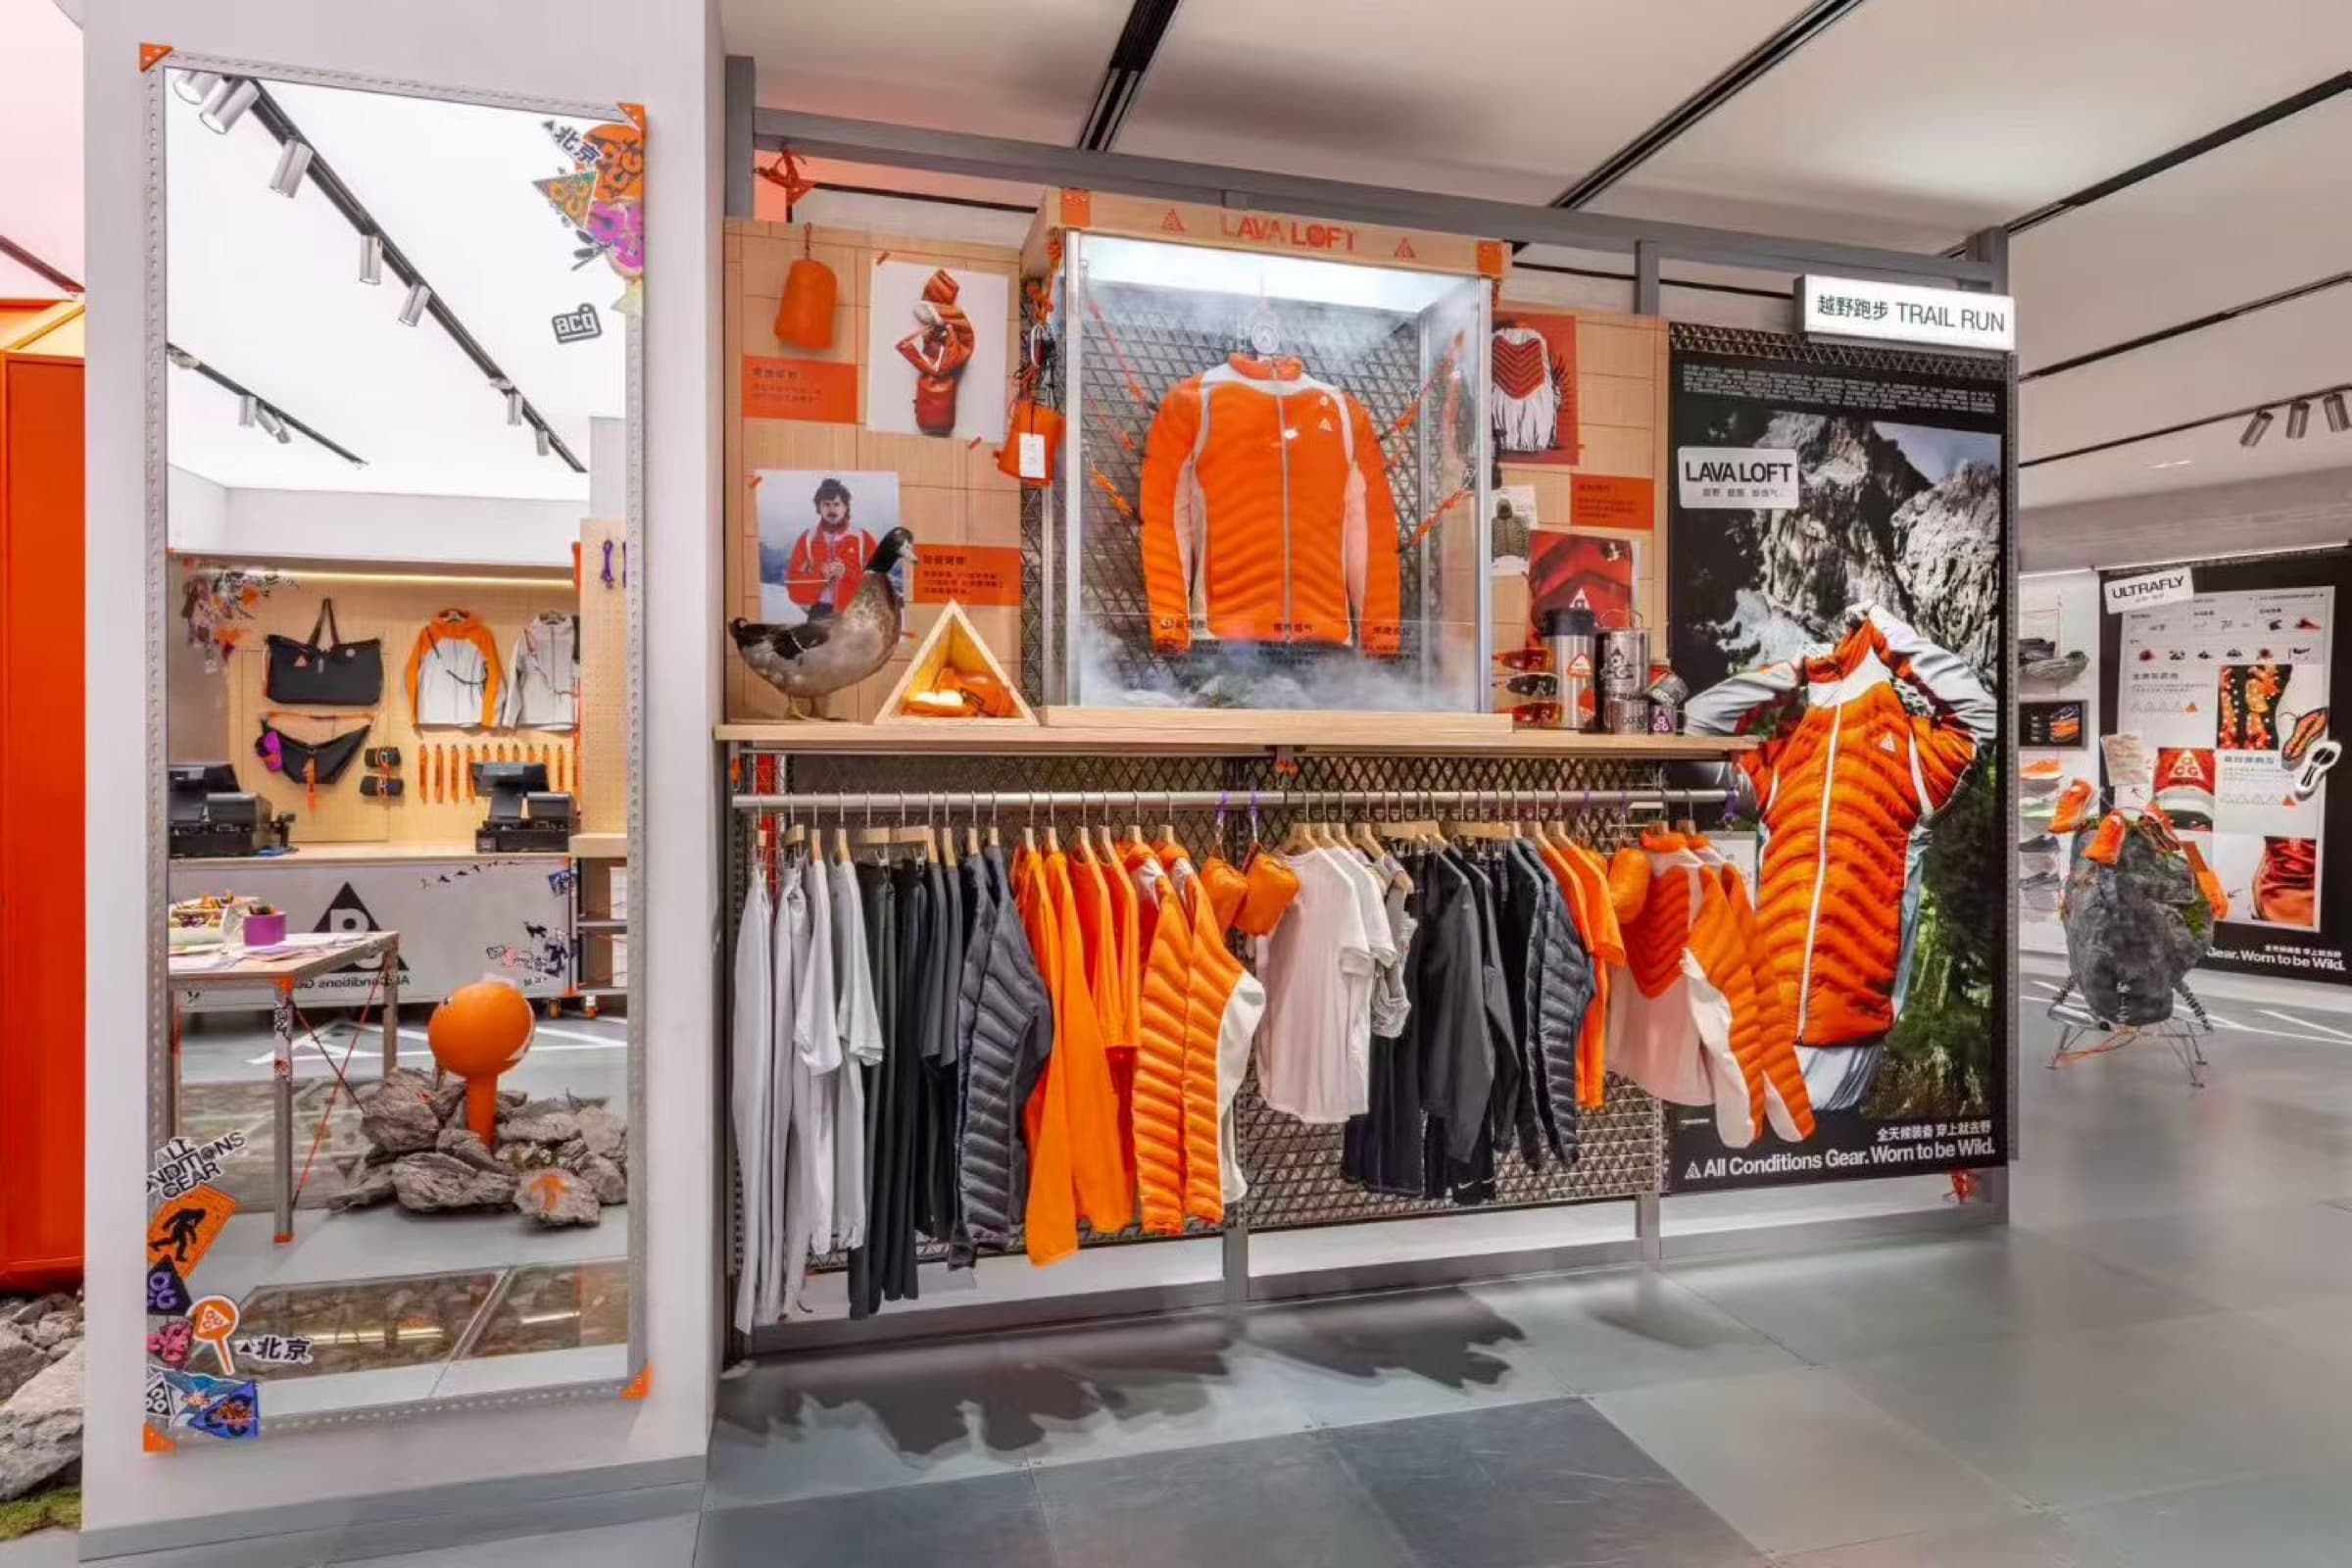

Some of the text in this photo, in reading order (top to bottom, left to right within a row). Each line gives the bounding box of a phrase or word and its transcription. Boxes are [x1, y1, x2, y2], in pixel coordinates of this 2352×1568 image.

[1221, 213, 1356, 252] LAVA LOFT
[1818, 294, 2005, 332] 越野跑步 TRAIL RUN
[1686, 462, 1792, 482] LAVA LOFT
[2113, 575, 2184, 598] ULTRAFLY
[2240, 950, 2276, 964] Worn
[2277, 953, 2291, 966] to
[2293, 956, 2311, 968] be
[1703, 1136, 1995, 1178] All Conditions Gear. Worn to be Wild.
[163, 1162, 221, 1198] GEAR
[256, 1336, 312, 1361] 北京
